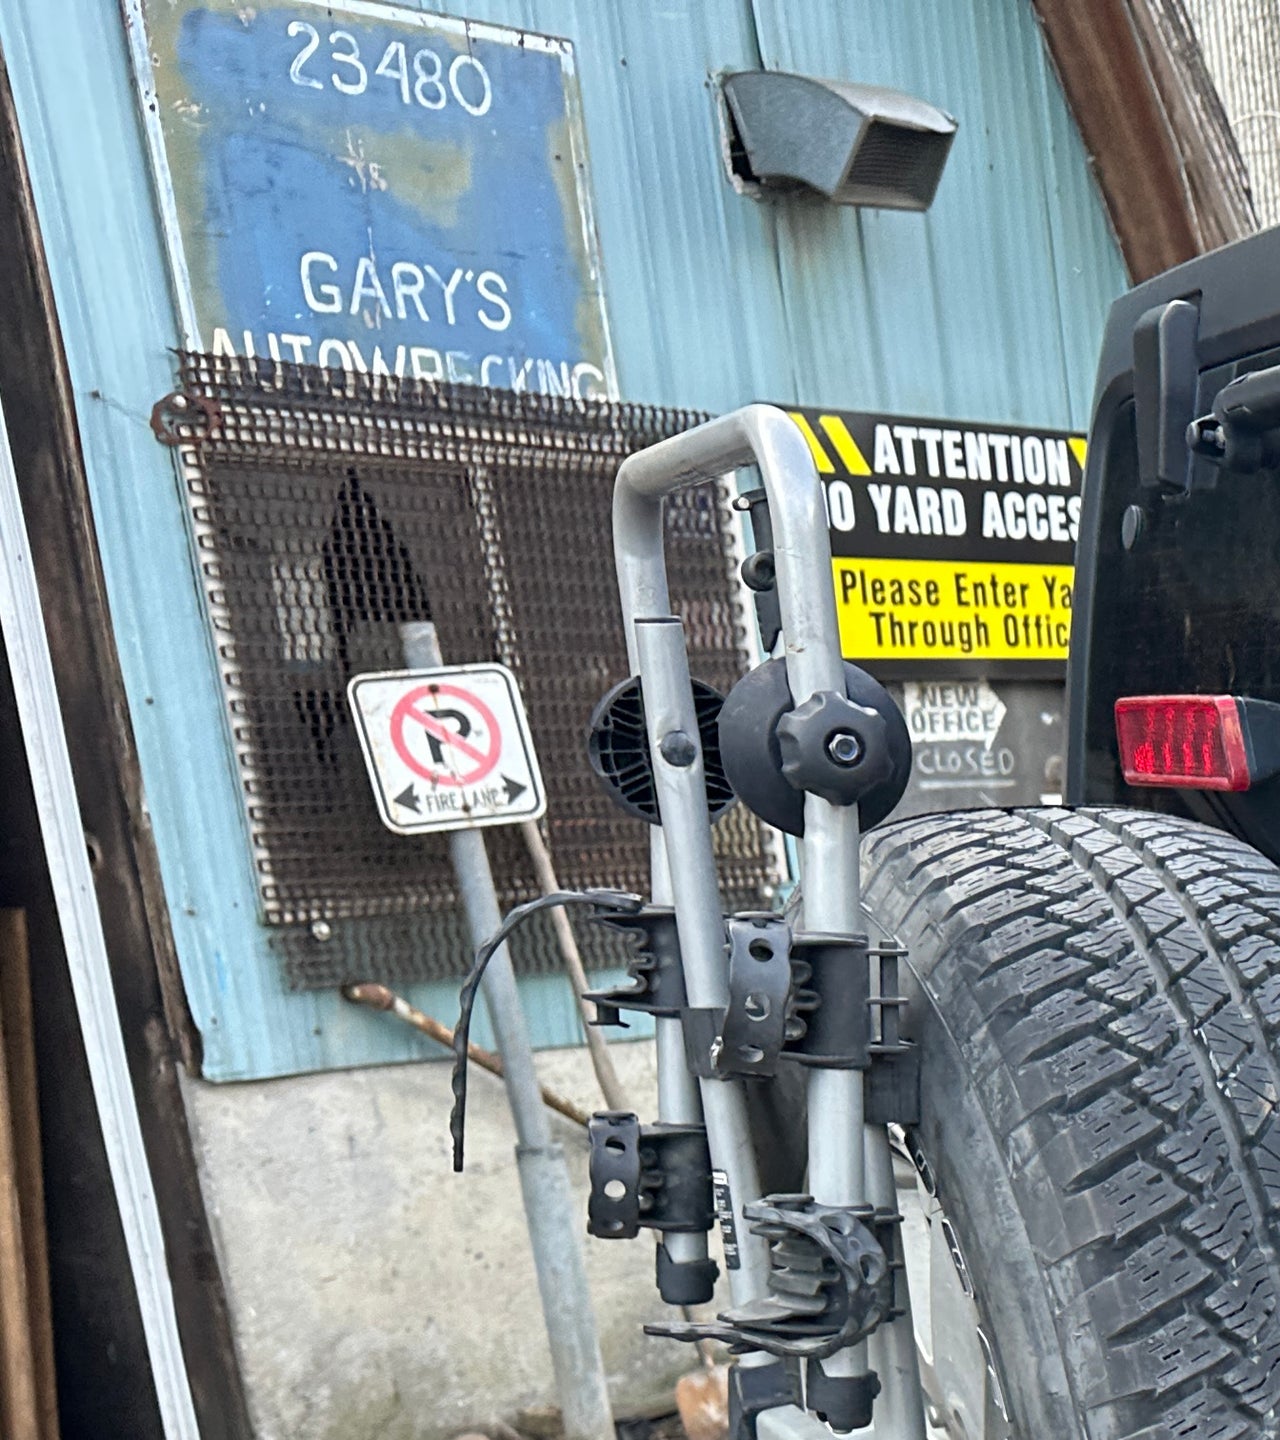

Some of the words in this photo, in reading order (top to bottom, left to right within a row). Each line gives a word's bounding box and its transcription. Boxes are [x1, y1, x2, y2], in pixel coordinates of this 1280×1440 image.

[287, 20, 492, 117] 23480
[299, 250, 513, 332] GARY'S
[873, 422, 1071, 487] ATTENTION
[867, 483, 968, 537] YARD
[839, 568, 941, 608] Please
[953, 572, 1030, 610] Enter
[868, 610, 991, 654] Through
[919, 683, 979, 709] NEW
[911, 706, 996, 734] OFFICE
[916, 747, 1015, 776] CLOSED
[425, 790, 458, 813] FIRE
